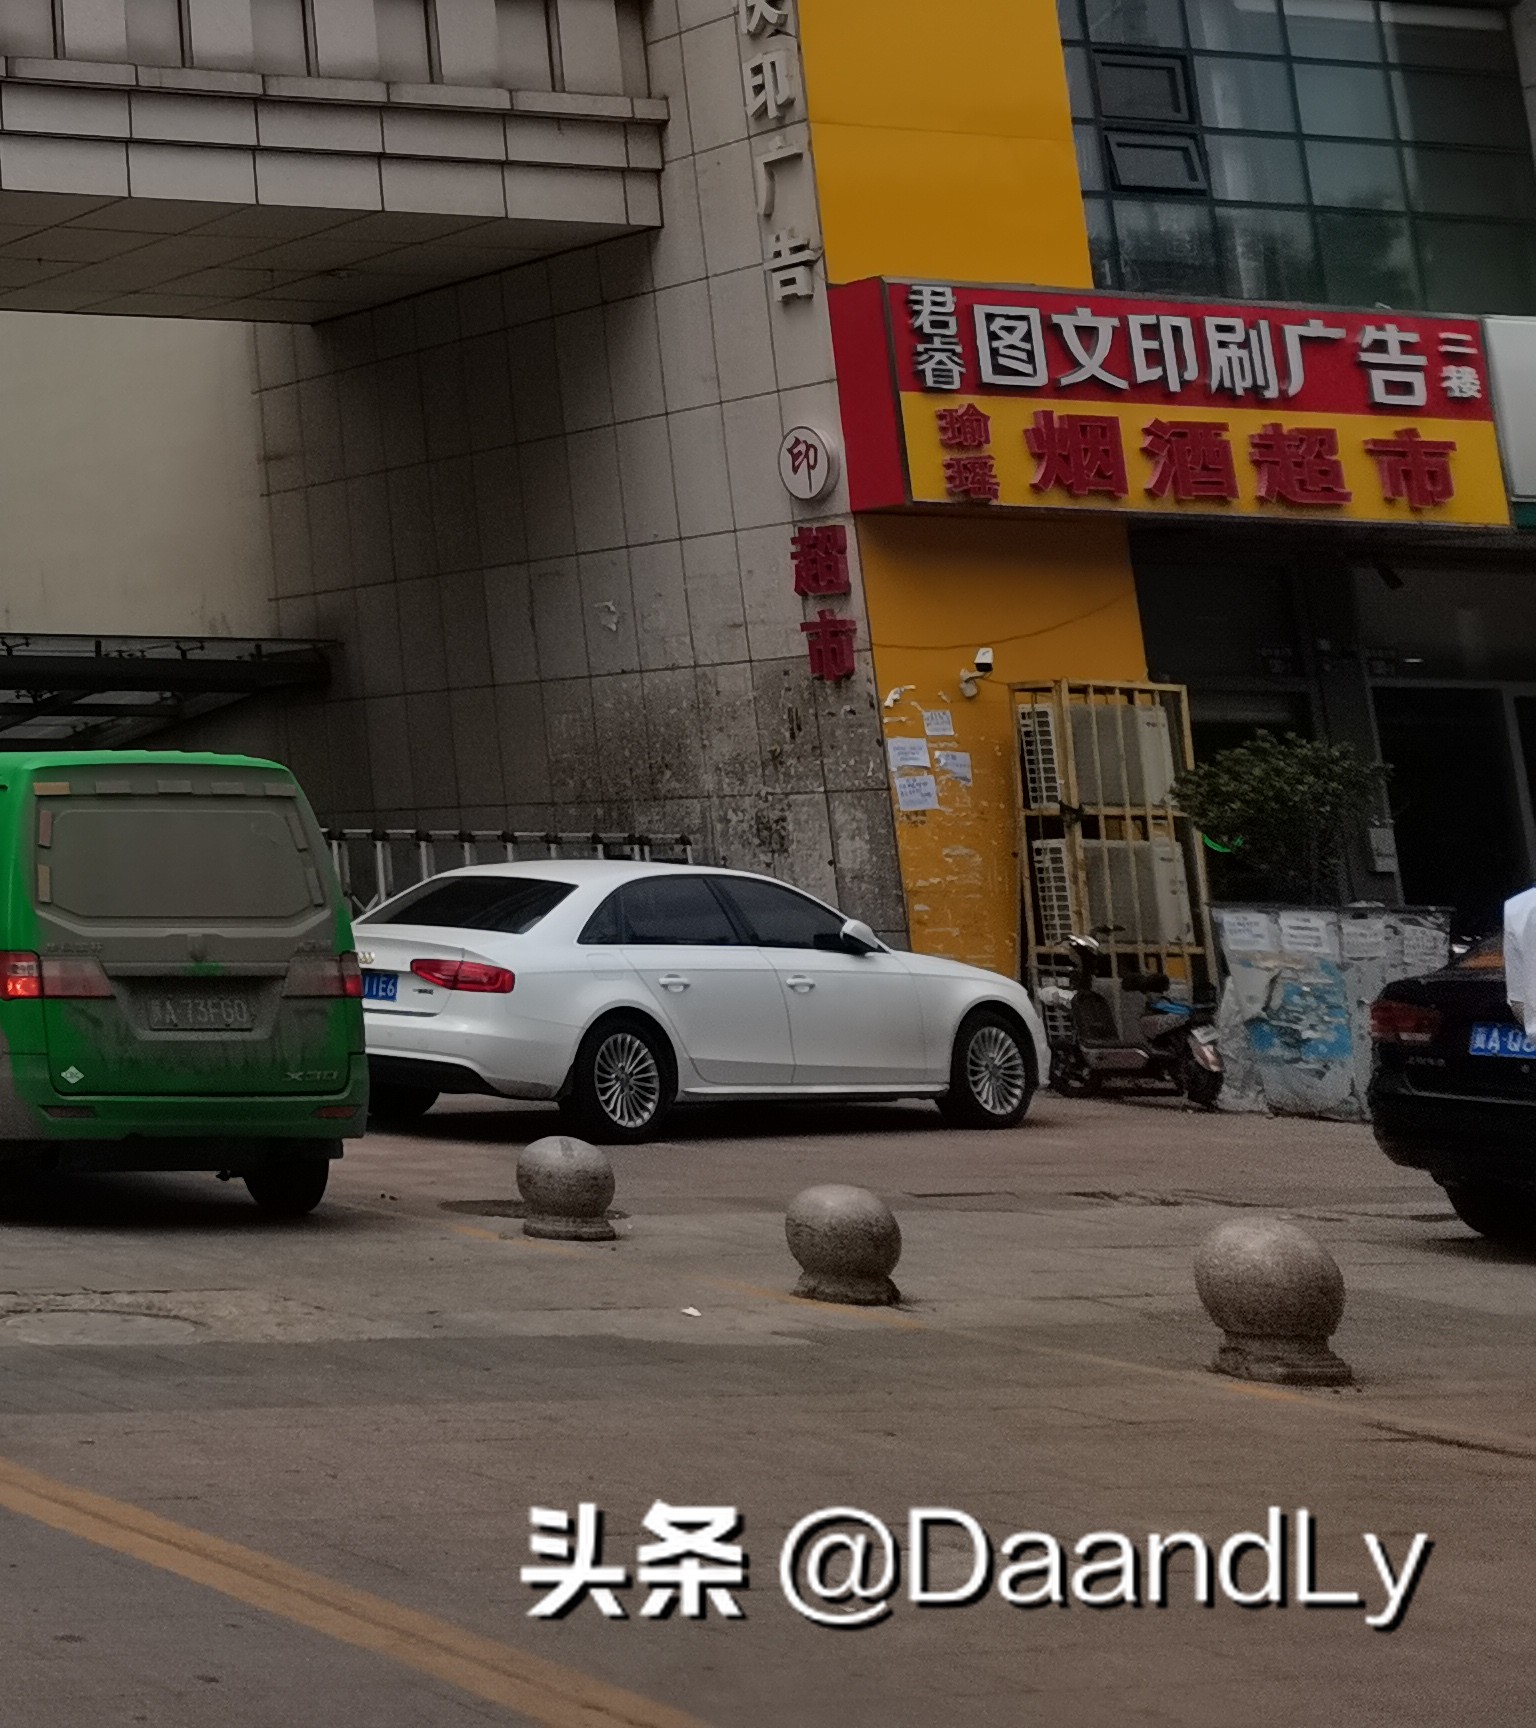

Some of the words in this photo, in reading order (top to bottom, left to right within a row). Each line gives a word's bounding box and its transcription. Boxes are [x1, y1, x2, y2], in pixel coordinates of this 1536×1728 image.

[908, 285, 967, 390] 君睿
[972, 303, 1428, 406] 图文印刷广告
[1438, 332, 1482, 399] 二楼
[1023, 409, 1458, 511] 烟酒超市
[789, 524, 858, 683] 超市
